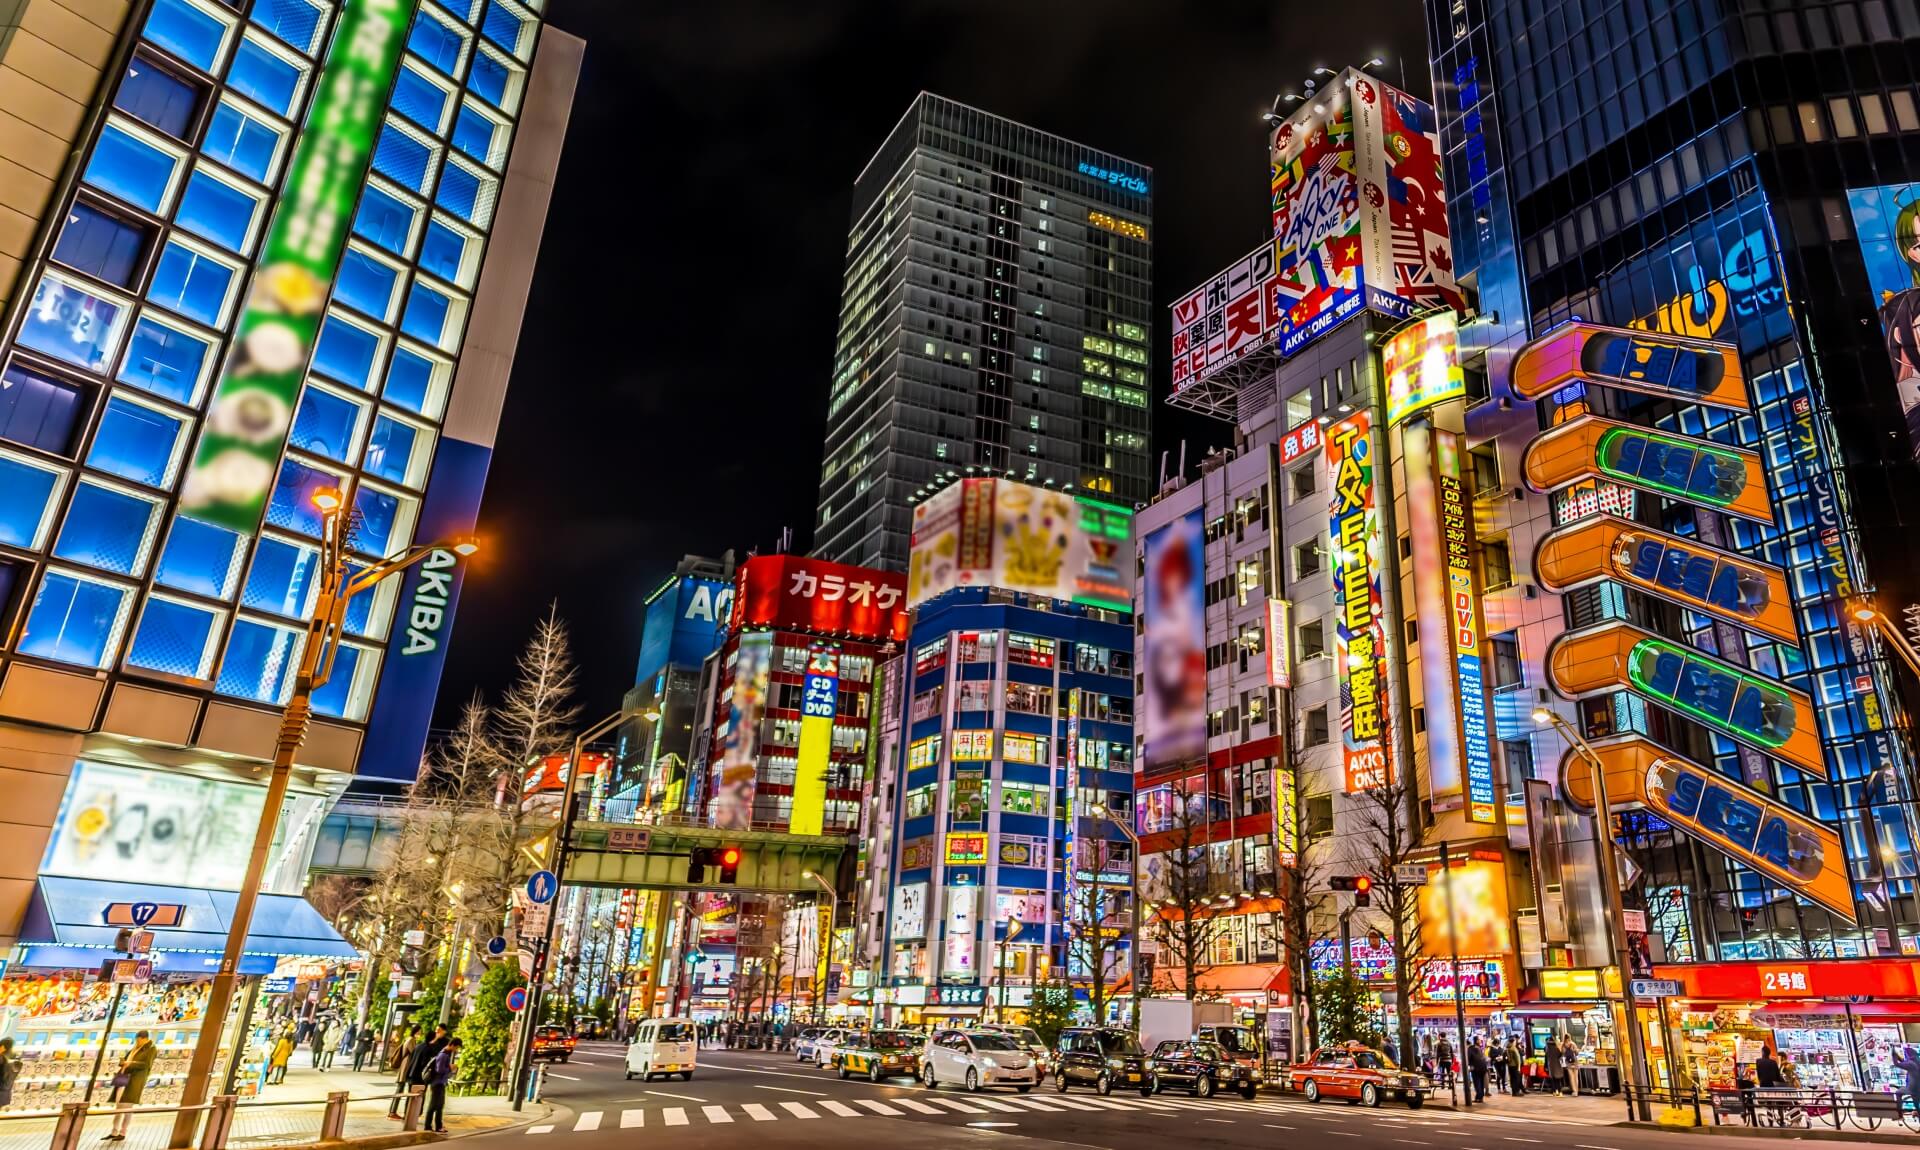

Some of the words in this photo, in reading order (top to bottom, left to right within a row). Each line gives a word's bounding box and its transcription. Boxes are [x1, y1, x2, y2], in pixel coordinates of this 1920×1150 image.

[1316, 211, 1340, 239] ONE
[1207, 249, 1273, 311] ボーク
[1173, 311, 1223, 355] 秋葉原
[1312, 313, 1332, 333] ONE
[1173, 343, 1224, 382] ホビー
[1196, 352, 1237, 381] AKIHABARA
[1284, 423, 1317, 460] 免税
[1335, 425, 1365, 514] TAX
[1441, 476, 1460, 491] ゲーム
[1445, 490, 1460, 502] CD
[1444, 502, 1464, 516] アイドル
[1445, 515, 1465, 529] アニメ
[1447, 529, 1465, 542] コミック
[1449, 543, 1467, 555] ホビー
[1340, 510, 1371, 631] FREE
[789, 569, 902, 610] カラオケ
[401, 549, 456, 655] AKIBA
[1455, 592, 1474, 648] DVD
[812, 677, 832, 690] CD
[806, 688, 834, 703] ゲーム
[805, 702, 833, 716] DVD
[1354, 768, 1386, 789] ONE
[136, 905, 154, 921] 17
[1765, 971, 1807, 991] 2号館
